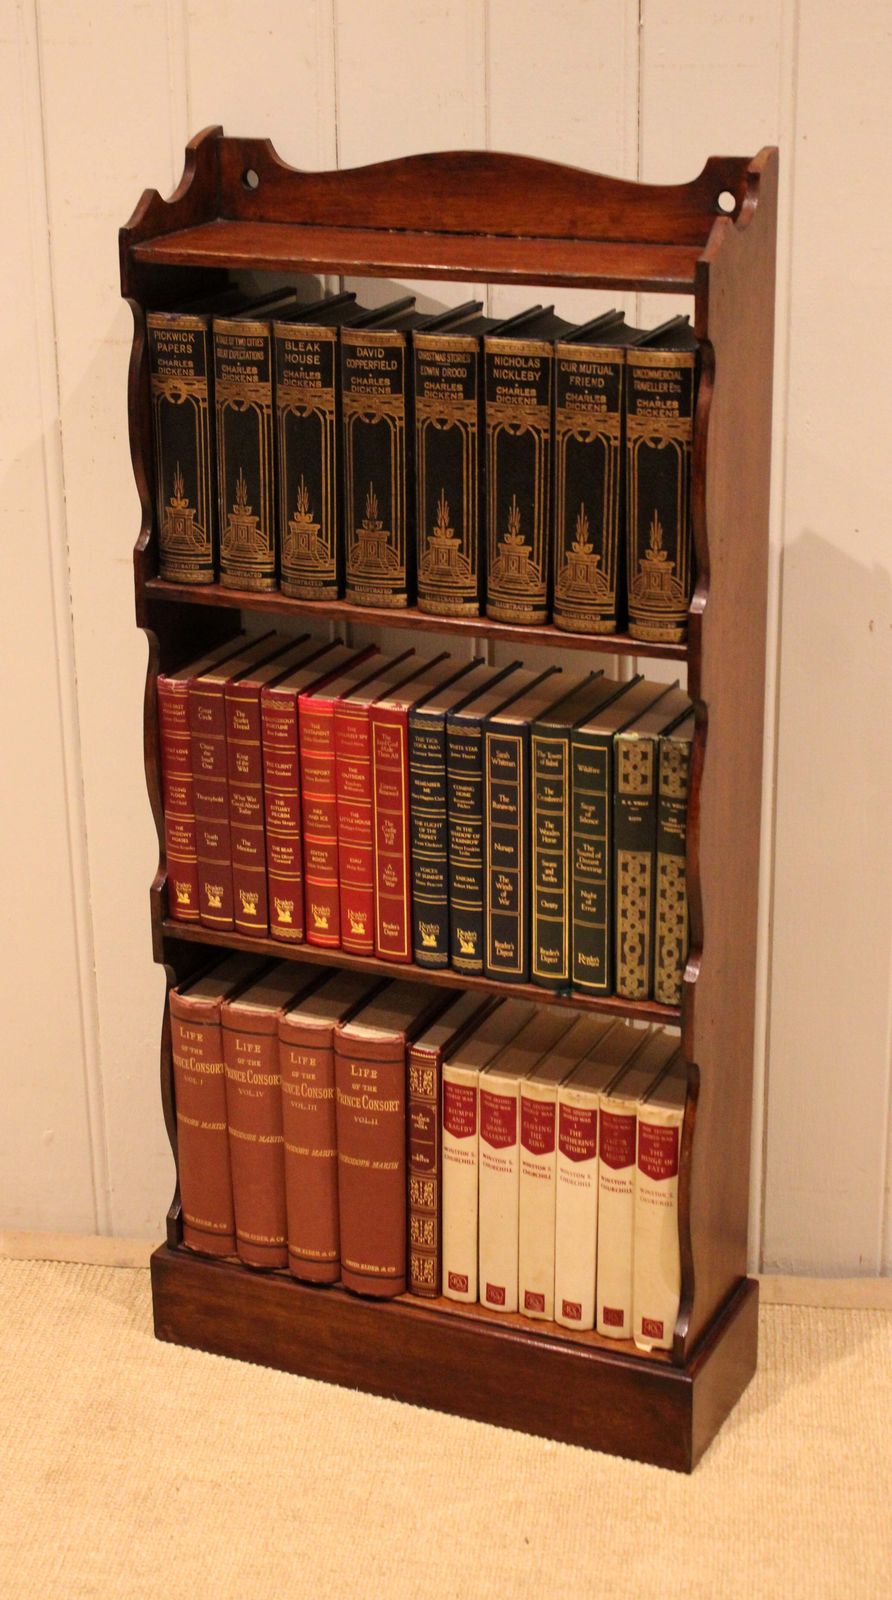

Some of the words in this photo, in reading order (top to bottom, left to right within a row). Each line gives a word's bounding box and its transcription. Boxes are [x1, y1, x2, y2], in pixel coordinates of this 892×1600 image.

[154, 330, 194, 342] PICKWICK
[158, 343, 192, 354] PAPERS
[285, 341, 320, 352] BLEAK
[356, 348, 384, 358] DAVID
[158, 359, 194, 368] CHARLES
[286, 353, 320, 365] HOUSE
[494, 356, 540, 368] NICHOLAS
[222, 365, 258, 374] CHARLES
[346, 359, 398, 370] COPPERFIELD
[560, 362, 578, 372] OUR
[580, 364, 614, 376] MUTUAL
[160, 367, 194, 376] DICKENS
[283, 370, 320, 379] CHARLES
[421, 366, 440, 376] EDWIN
[442, 368, 468, 378] DROOD
[493, 369, 541, 380] NICKLEBY
[222, 373, 258, 383] DICKENS
[284, 378, 322, 388] DICKENS
[351, 376, 390, 386] CHARLES
[570, 376, 604, 388] FRIEND
[352, 384, 392, 394] DICKENS
[424, 382, 464, 392] CHARLES
[496, 386, 536, 396] CHARLES
[424, 390, 464, 400] DICKENS
[496, 395, 538, 405] DICKENS
[566, 393, 606, 403] CHARLES
[566, 402, 608, 412] DICKENS
[636, 400, 678, 410] CHARLES
[637, 408, 680, 418] DICKENS
[544, 786, 554, 794] The
[499, 794, 509, 802] The
[544, 820, 554, 829] The
[499, 875, 510, 883] The
[180, 1026, 203, 1042] LIFE
[190, 1047, 203, 1056] THE
[236, 1039, 261, 1054] LIFE
[238, 1057, 246, 1065] OF
[248, 1059, 261, 1067] THE
[290, 1052, 316, 1066] LIFE
[224, 1063, 246, 1082] PRINCE
[302, 1072, 316, 1080] THE
[350, 1064, 378, 1079] LIFE
[362, 1084, 378, 1093] THE
[336, 1087, 361, 1108] PRINCE
[362, 1095, 400, 1112] CONSORT
[572, 1108, 592, 1116] SECOND
[452, 1116, 465, 1124] AND
[524, 1121, 552, 1133] CLOSING
[530, 1131, 542, 1140] THE
[570, 1130, 582, 1138] THE
[529, 1138, 544, 1149] RING
[560, 1134, 594, 1148] GATHERING
[444, 1146, 470, 1158] WINSTON
[566, 1144, 587, 1154] STORM
[650, 1150, 664, 1158] THE
[482, 1152, 506, 1164] WINSTON
[641, 1155, 662, 1165] HINGE
[372, 1160, 400, 1170] MARTIN
[482, 1162, 512, 1174] CHURCHILL
[522, 1160, 546, 1171] WINSTON
[648, 1164, 666, 1174] FATE
[522, 1168, 552, 1180] CHURCHILL
[560, 1168, 586, 1179] WINSTON
[560, 1176, 591, 1188] CHURCHILL
[600, 1176, 626, 1186] WINSTON
[600, 1183, 632, 1194] CHURCHILL
[640, 1188, 666, 1198] WINSTON
[640, 1196, 674, 1208] CHURCHILL
[361, 1262, 380, 1272] ELDER
